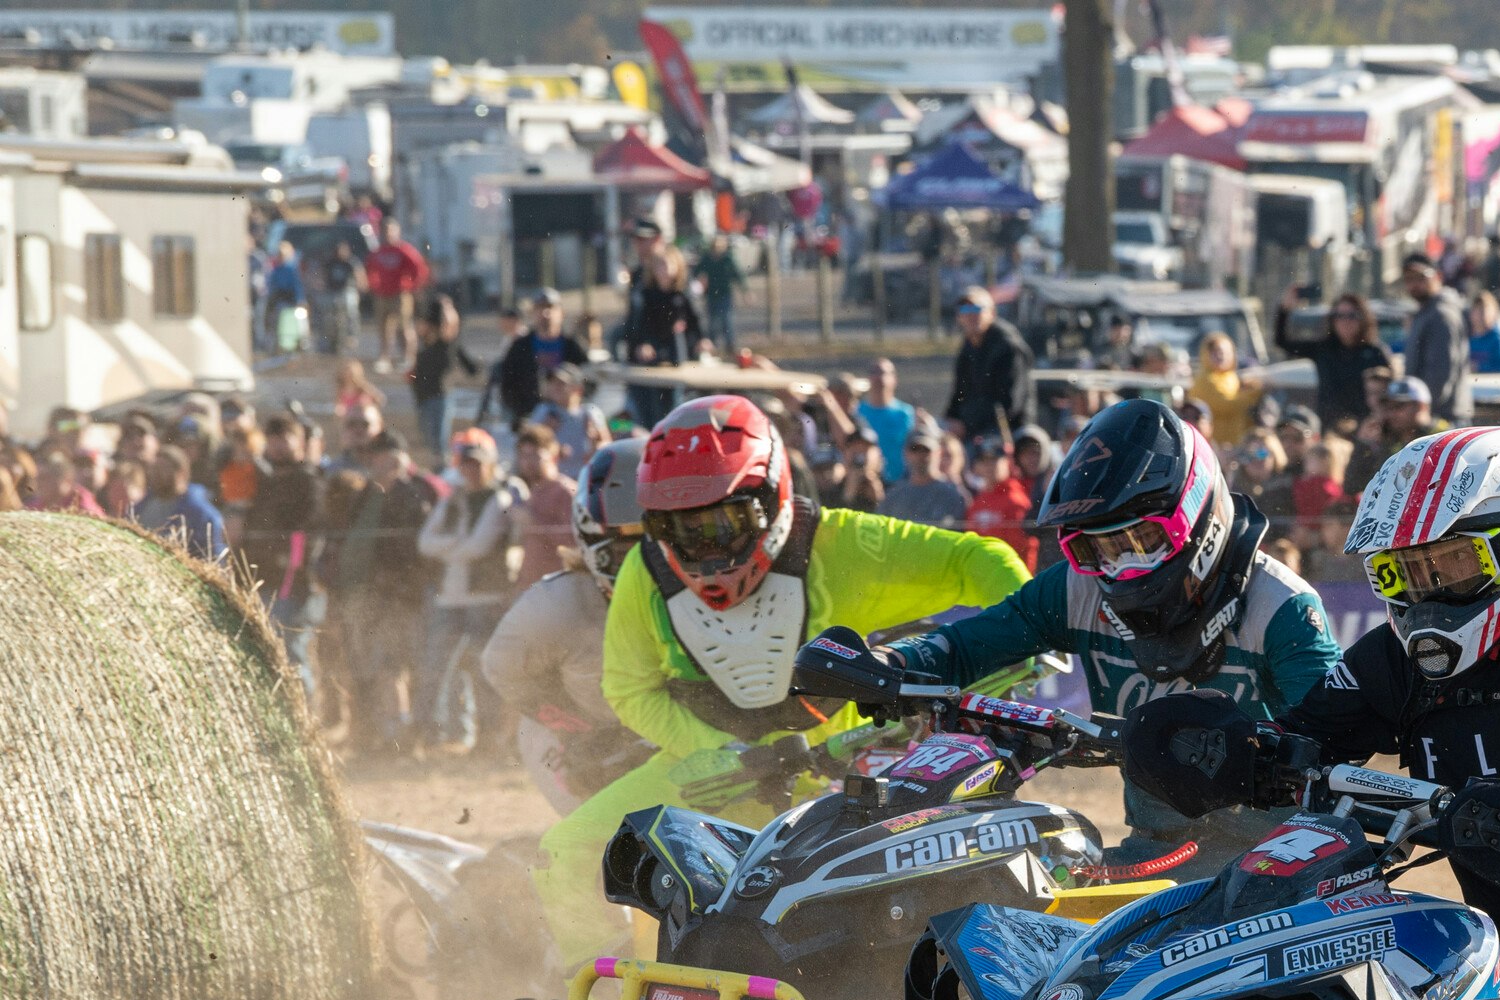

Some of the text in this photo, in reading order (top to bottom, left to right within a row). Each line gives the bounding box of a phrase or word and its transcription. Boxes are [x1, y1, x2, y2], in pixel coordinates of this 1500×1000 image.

[1193, 521, 1223, 577] 784
[1200, 597, 1239, 647] LEATT
[891, 745, 970, 776] 784
[1345, 776, 1414, 798] handlebars
[885, 818, 1039, 874] can-am
[1252, 828, 1337, 863] 4
[1282, 820, 1352, 845] GNCCRACING.COM
[748, 880, 770, 888] BRP
[1336, 866, 1376, 888] FASST
[1325, 894, 1414, 916] KENDA
[1162, 911, 1294, 967] can-am
[1228, 918, 1397, 981] TENNESSEE
